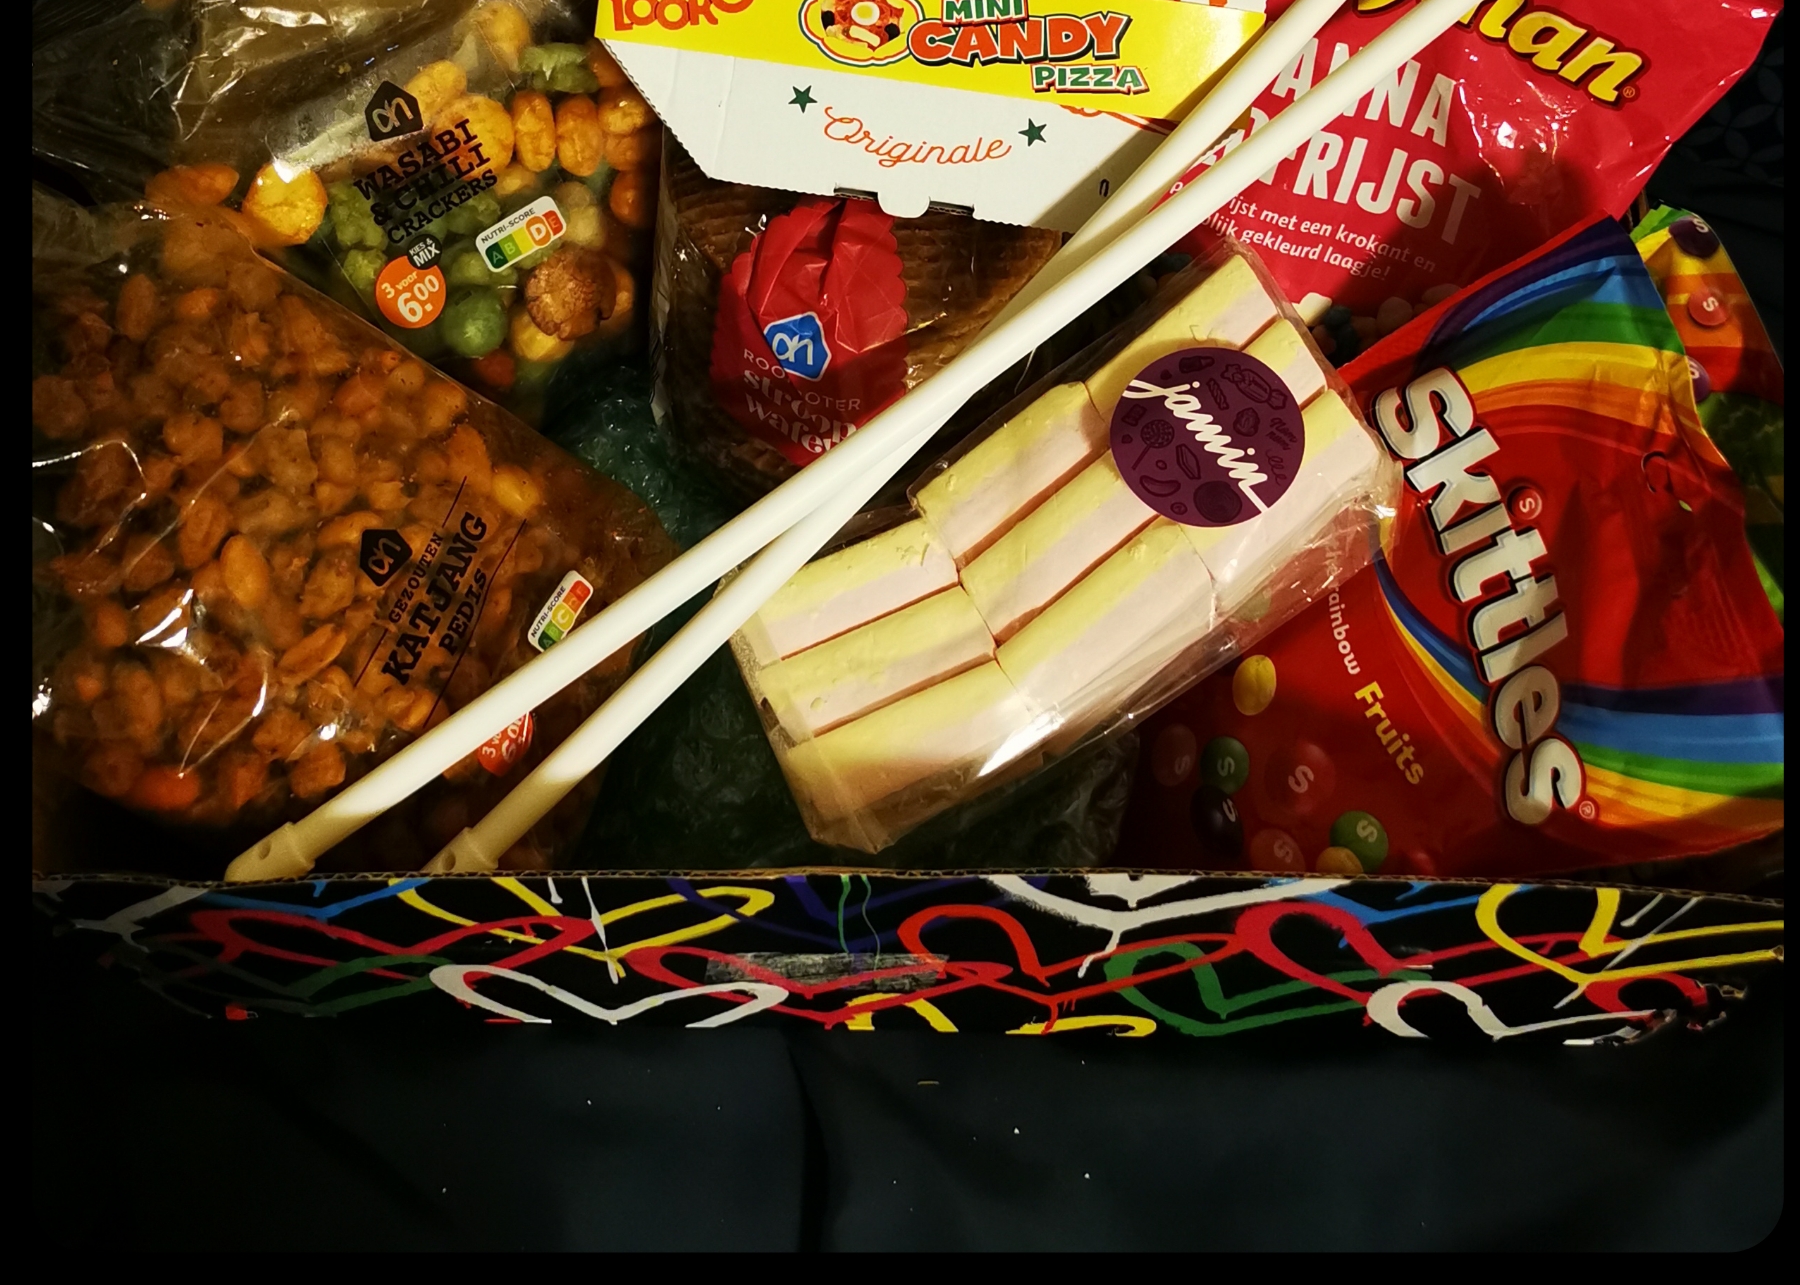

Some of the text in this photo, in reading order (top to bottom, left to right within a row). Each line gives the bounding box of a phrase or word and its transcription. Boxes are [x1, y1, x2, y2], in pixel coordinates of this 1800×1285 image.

[907, 11, 1131, 67] CANDY
[1032, 64, 1149, 93] PIZZA
[353, 118, 478, 201] WASABI
[823, 105, 1012, 169] Originale
[369, 142, 491, 226] & CHILI
[387, 169, 498, 245] CRACKERS
[409, 240, 425, 257] KIES
[413, 244, 441, 268] MIX
[480, 207, 535, 245] NUTRI-SCORE
[1240, 229, 1391, 281] gekleurd laagje!
[1260, 208, 1437, 273] met een krokant en
[381, 271, 418, 299] 3 voor
[745, 393, 832, 454] wafe
[1122, 378, 1268, 515] jamin
[381, 511, 488, 686] KATJANG
[388, 531, 444, 624] GEZOUTEN
[1375, 366, 1586, 826] Skittles
[438, 567, 488, 657] PEDIS
[530, 585, 566, 639] NUTRI-SCORE
[1354, 681, 1424, 786] Fruits
